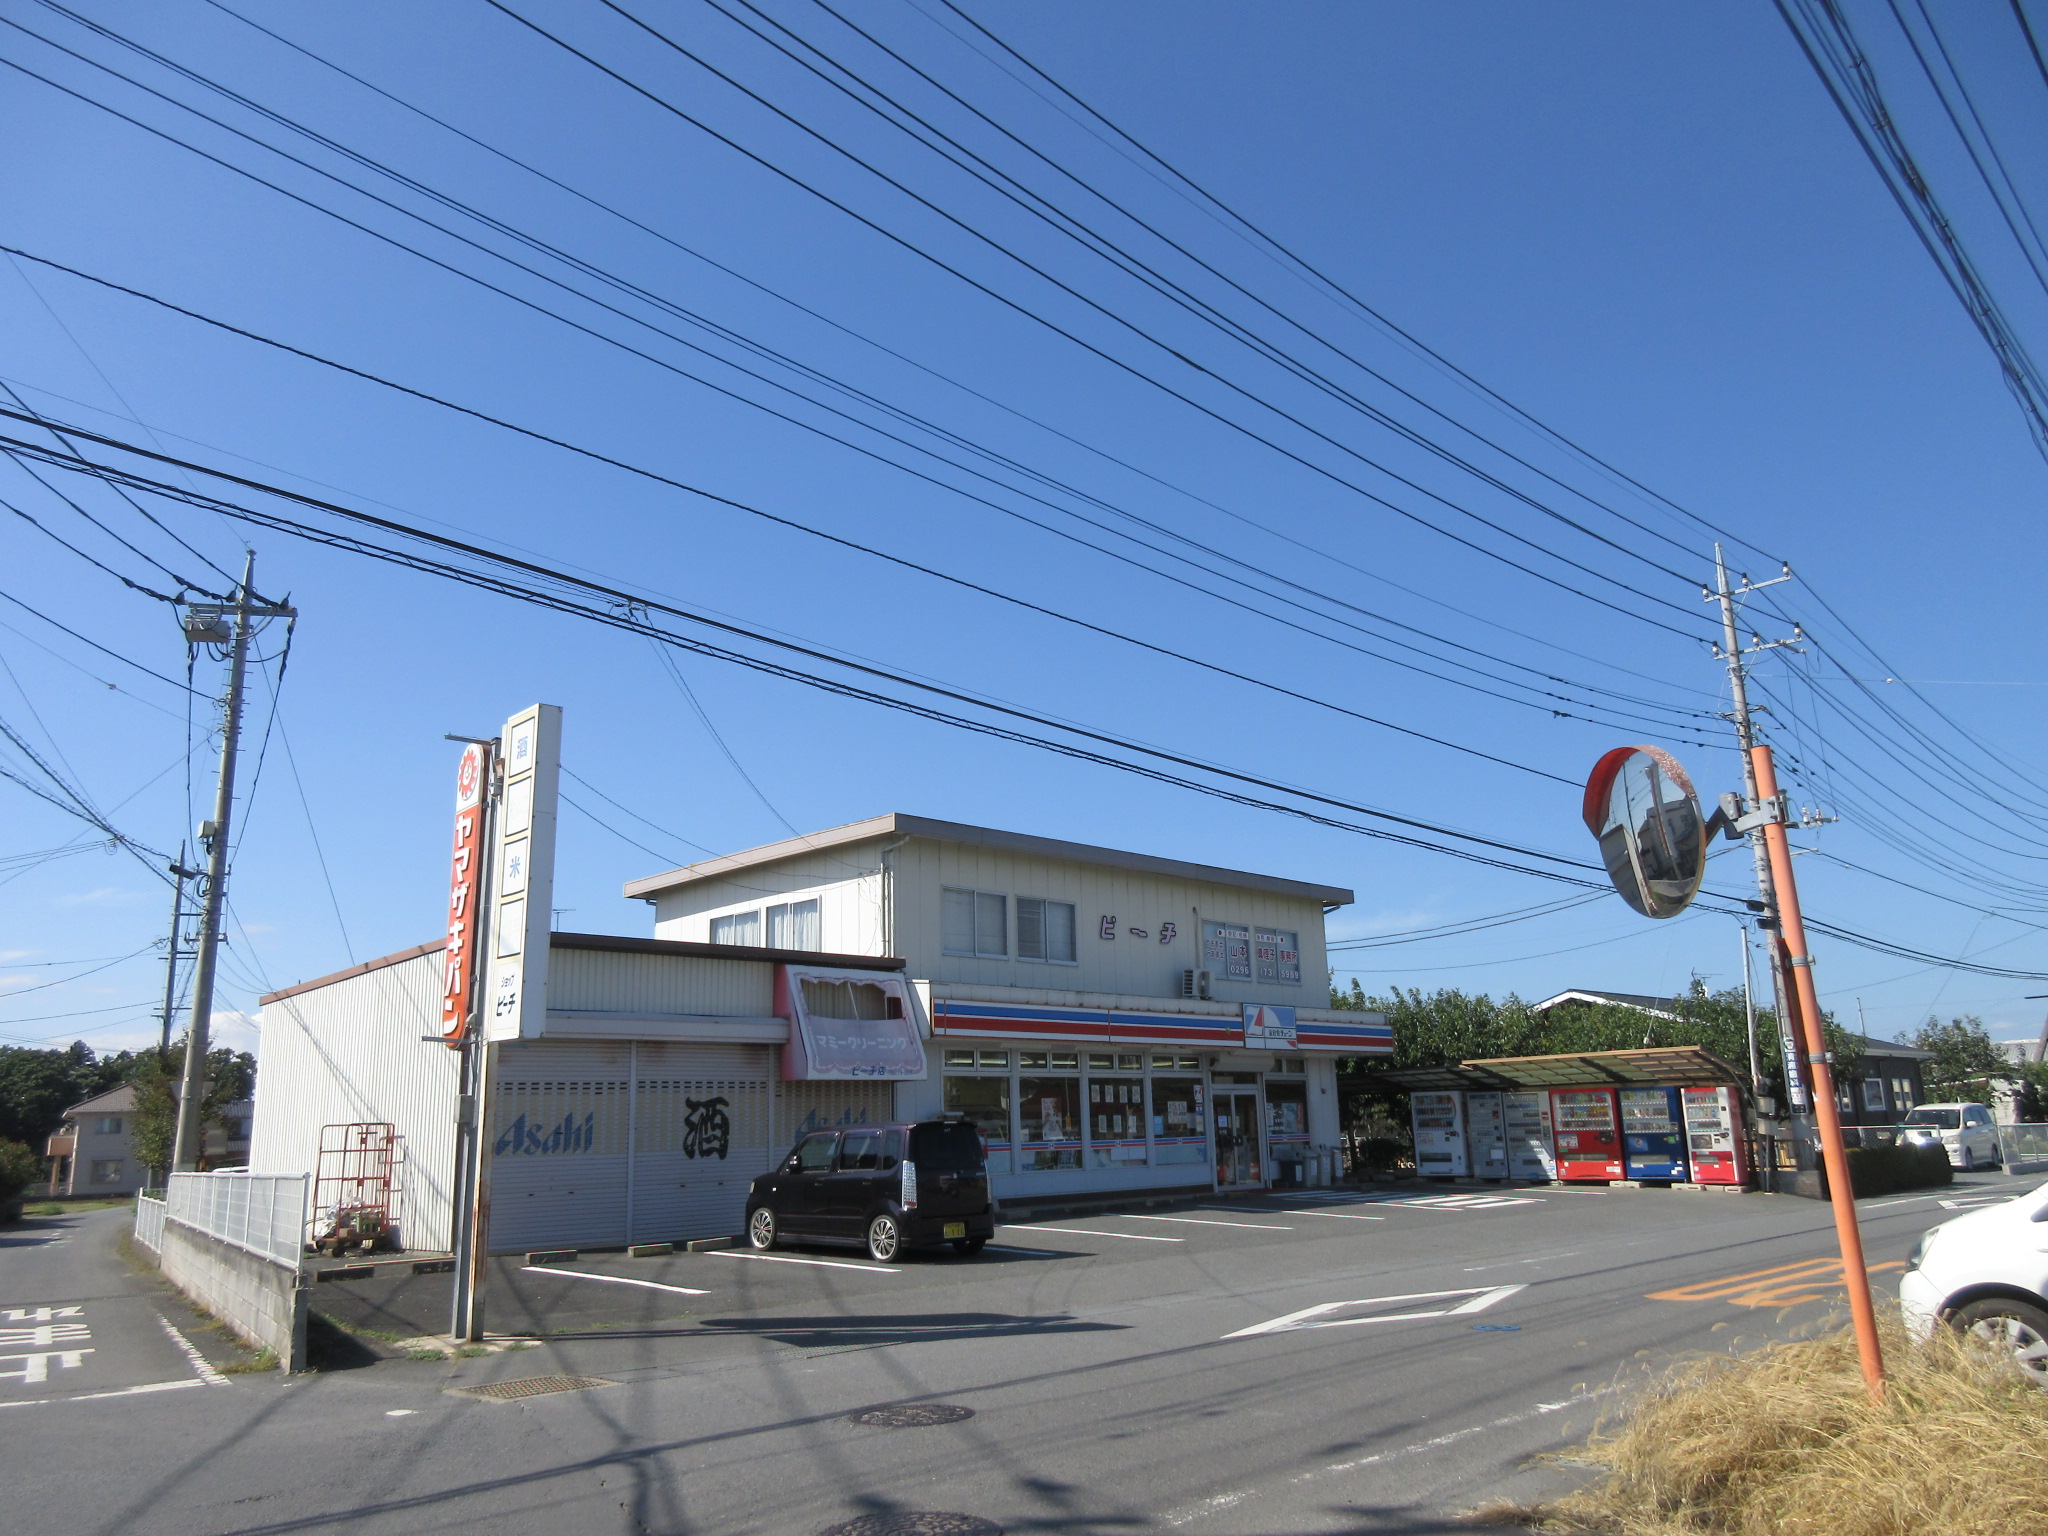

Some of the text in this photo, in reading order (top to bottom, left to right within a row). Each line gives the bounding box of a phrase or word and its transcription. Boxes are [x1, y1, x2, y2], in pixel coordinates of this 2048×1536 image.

[509, 855, 521, 879] 米
[443, 814, 474, 1037] ヤマザキパン
[1230, 944, 1248, 959] 山本
[1230, 965, 1250, 976] 0296
[494, 1111, 594, 1156] Asahi
[682, 1096, 730, 1161] 酒
